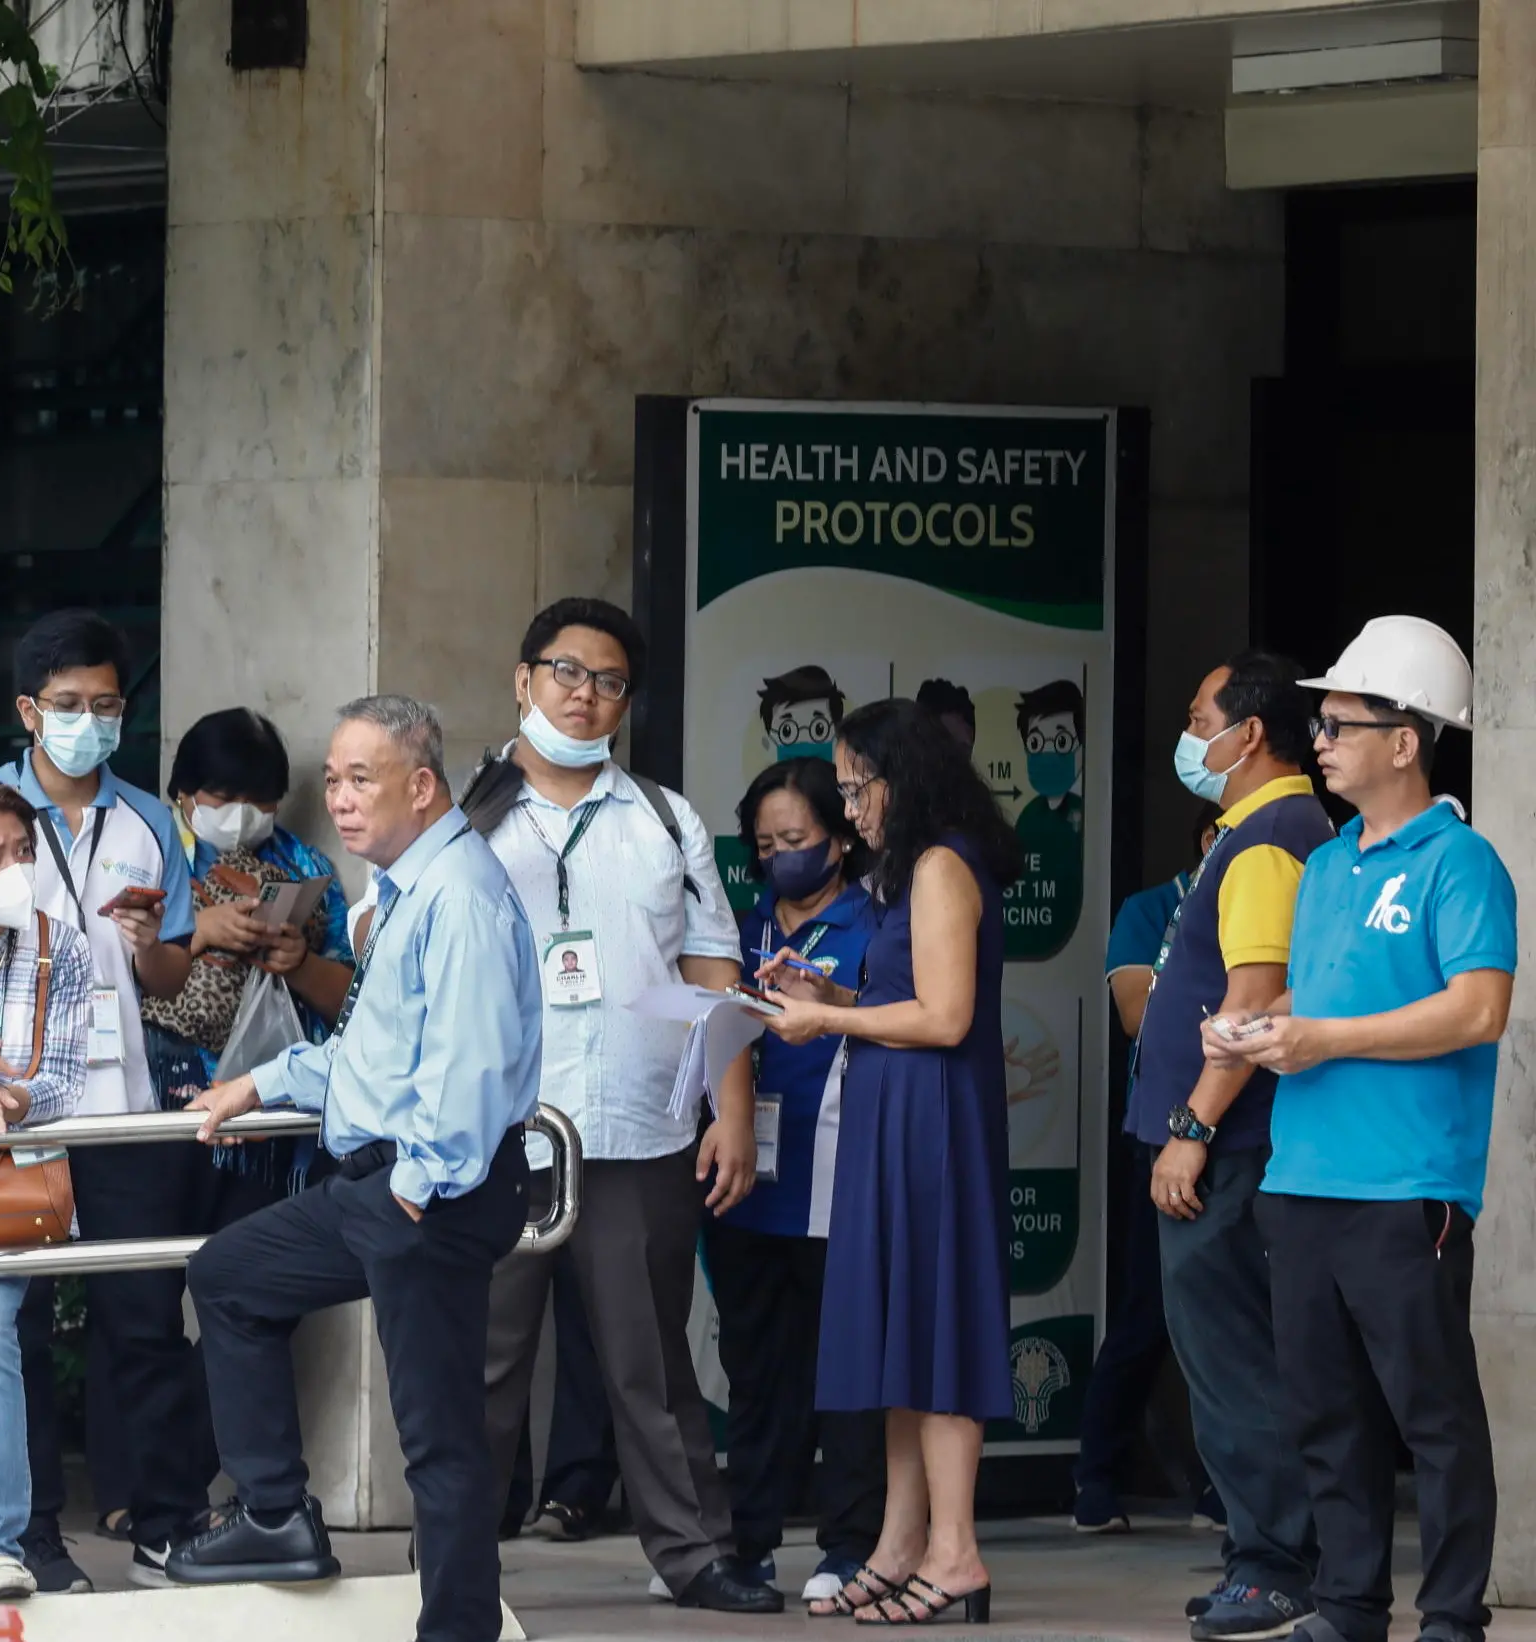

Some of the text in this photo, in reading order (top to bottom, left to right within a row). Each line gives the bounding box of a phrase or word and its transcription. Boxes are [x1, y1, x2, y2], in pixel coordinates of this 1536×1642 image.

[721, 443, 1087, 487] HEALTH AND SAFETY
[775, 500, 1036, 548] PROTOCOLS
[987, 760, 1012, 780] 1M
[1032, 880, 1056, 899] 1M
[1002, 906, 1053, 926] CING
[1011, 1212, 1062, 1233] YOUR
